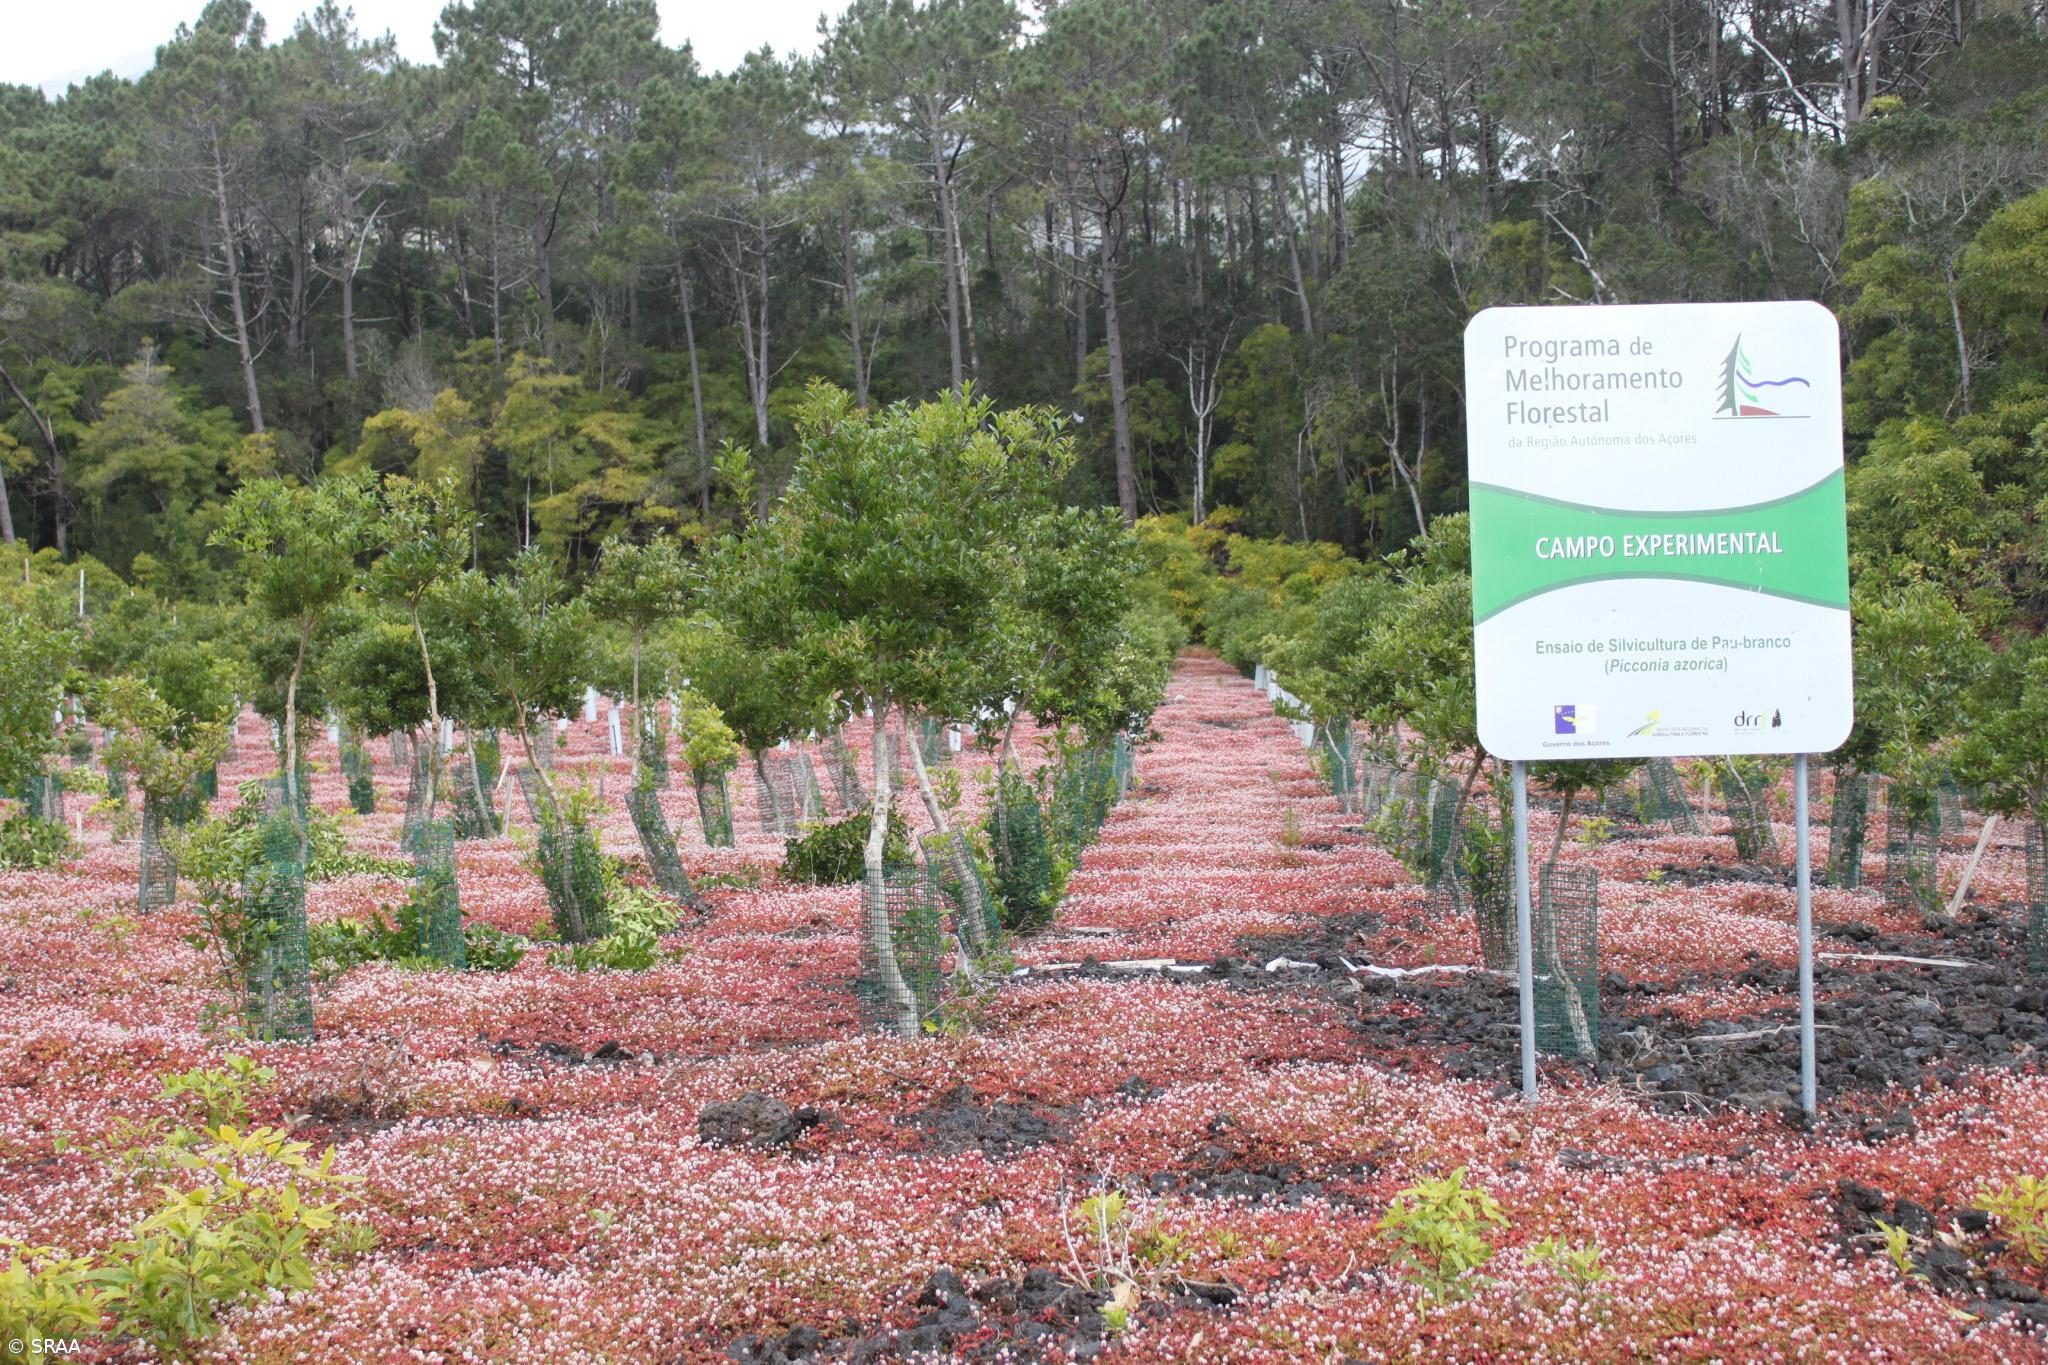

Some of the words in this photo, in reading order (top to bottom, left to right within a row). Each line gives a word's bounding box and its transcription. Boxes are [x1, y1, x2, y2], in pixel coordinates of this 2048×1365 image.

[1505, 335, 1620, 363] Programa
[1630, 335, 1653, 355] de
[1506, 367, 1683, 392] Melhoramento
[1507, 398, 1609, 424] Florestal
[1508, 436, 1522, 448] da
[1527, 435, 1566, 450] Região
[1570, 434, 1631, 447] Autónoma
[1635, 433, 1655, 445] dos
[1659, 432, 1697, 447] Açores
[1536, 535, 1614, 559] CAMPO
[1623, 531, 1783, 557] EXPERIMENTAL
[1535, 640, 1583, 654] Ensaio
[1587, 639, 1604, 653] de
[1608, 637, 1687, 653] Silvicultura
[1691, 637, 1708, 651] de
[1712, 635, 1791, 651] Pau-branco
[1604, 658, 1669, 676] (Picconia
[1673, 656, 1728, 673] azorica)
[1587, 740, 1610, 748] Açores
